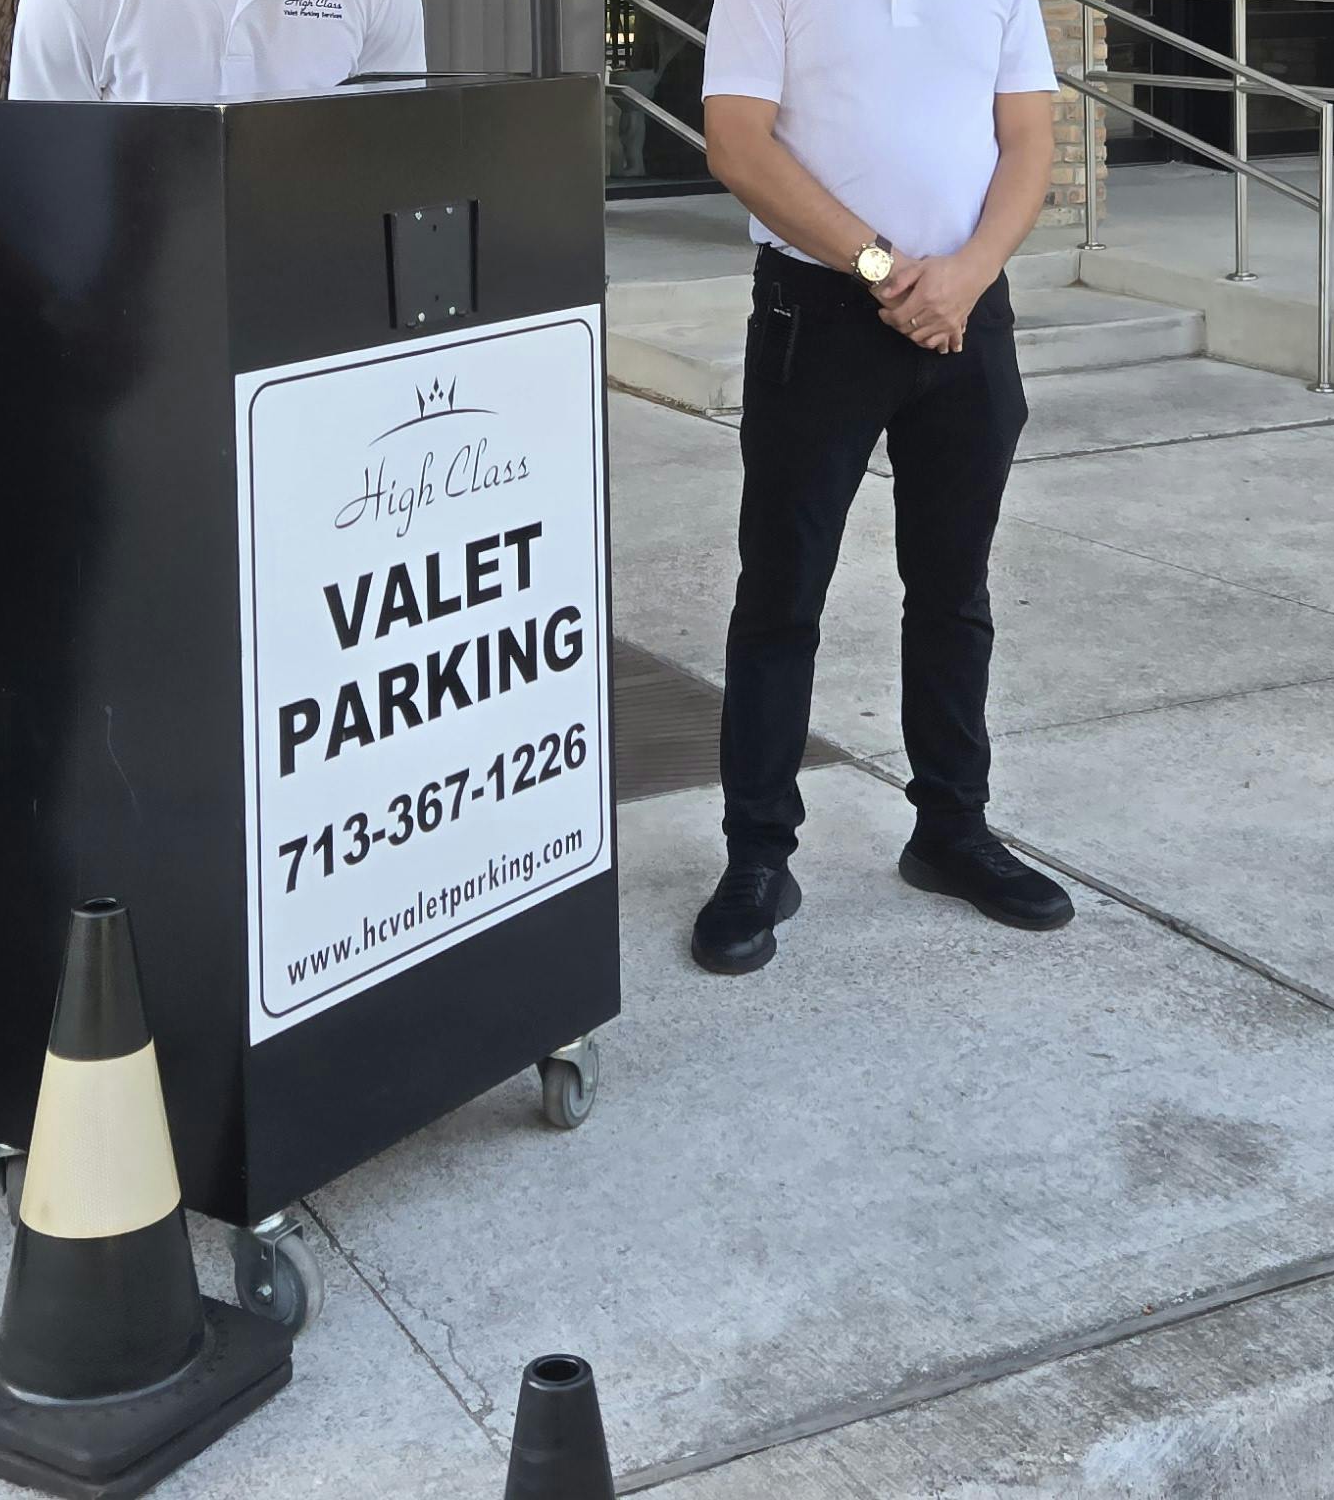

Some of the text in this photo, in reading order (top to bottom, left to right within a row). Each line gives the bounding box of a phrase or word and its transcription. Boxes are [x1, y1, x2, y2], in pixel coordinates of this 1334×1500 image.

[334, 437, 530, 538] High Class
[323, 521, 543, 650] VALET
[279, 605, 584, 778] PARKING
[278, 722, 587, 894] 713-367-1226
[287, 828, 583, 986] www.hcvaletparking.com
